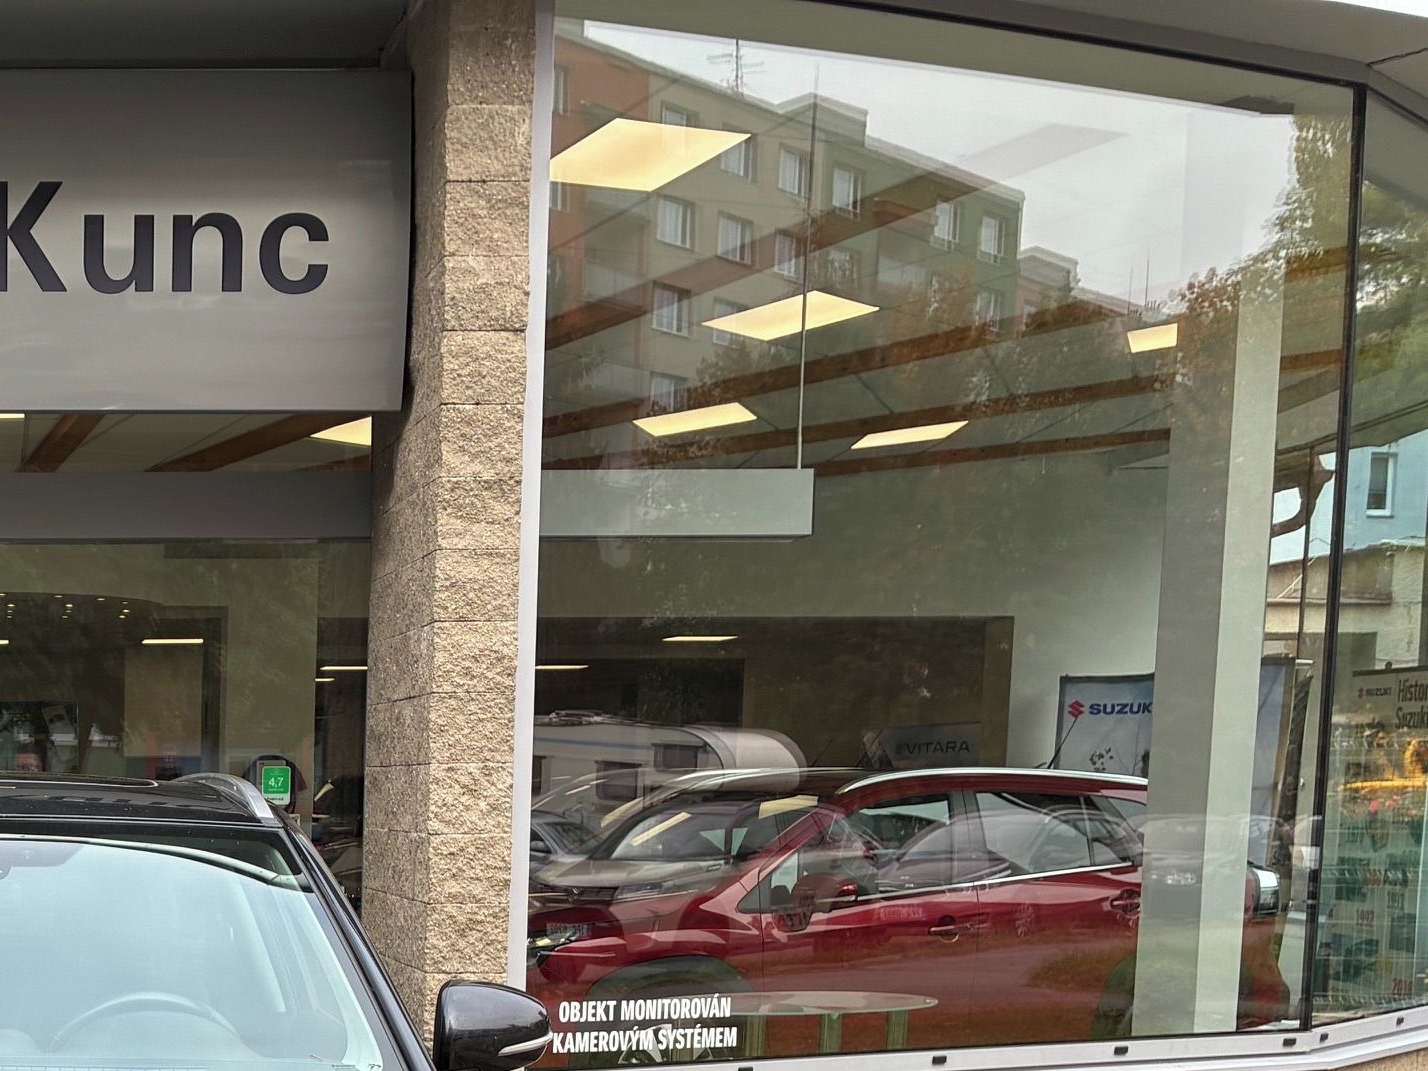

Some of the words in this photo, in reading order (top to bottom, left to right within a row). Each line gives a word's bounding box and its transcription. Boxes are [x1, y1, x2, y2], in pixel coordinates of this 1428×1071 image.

[268, 777, 284, 788] 4,7
[558, 1000, 616, 1023] OBJEKT
[620, 993, 732, 1022] MONITOROVÁN
[552, 1026, 654, 1054] KAMEROVÝM
[657, 1023, 738, 1050] SYSTÉMEM
